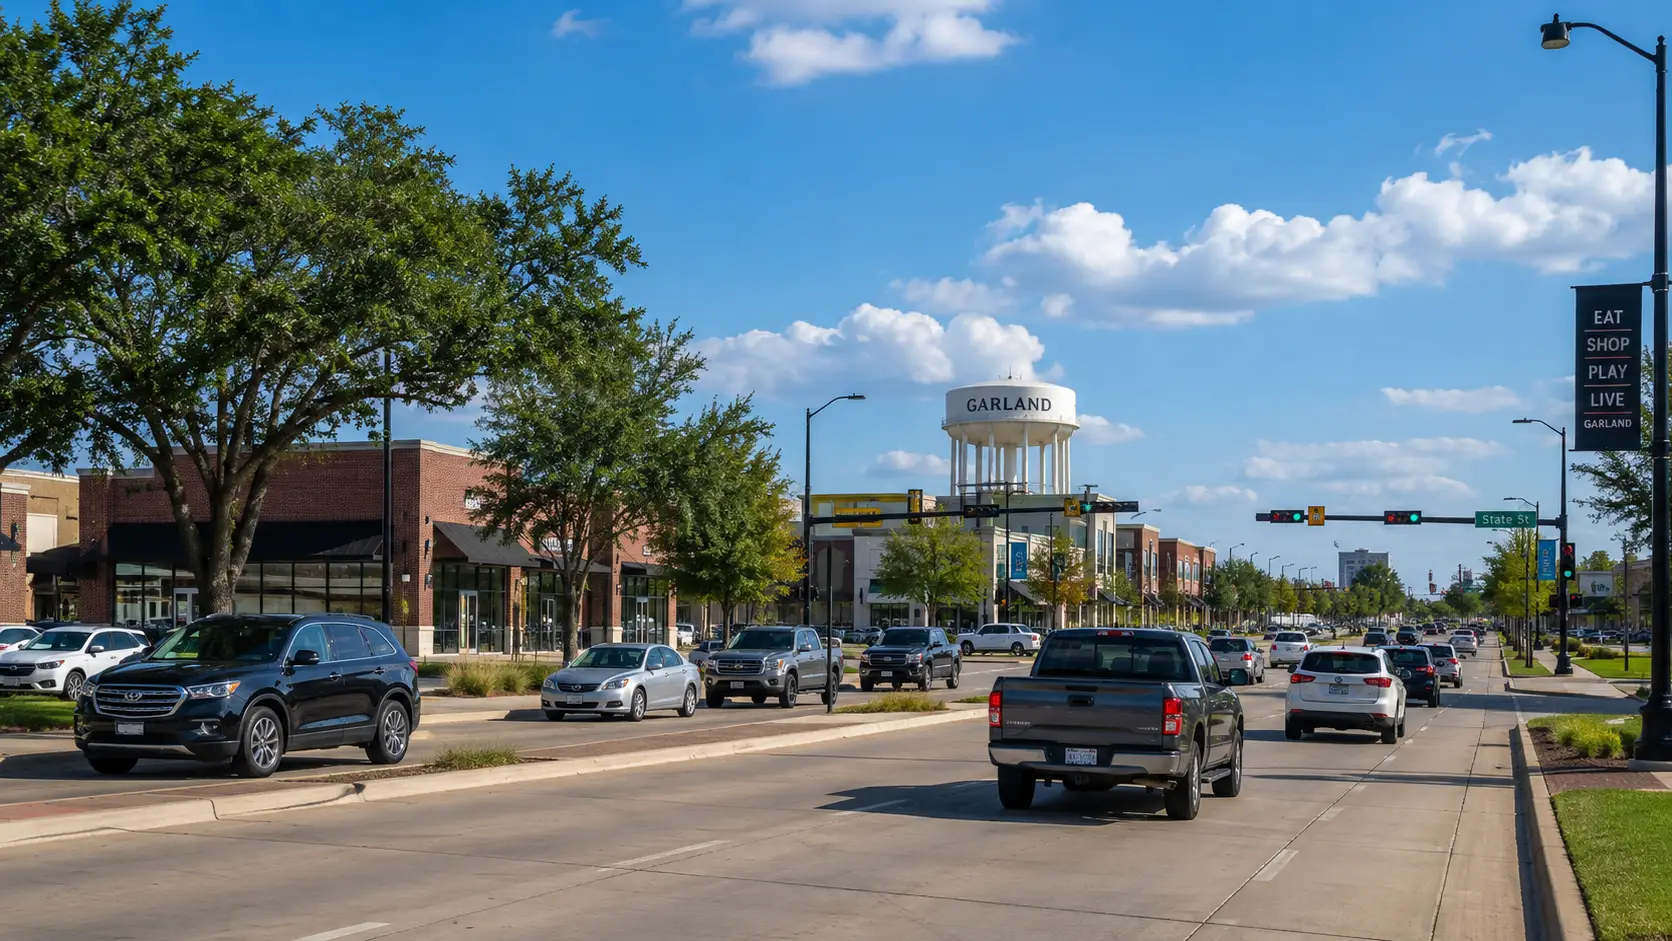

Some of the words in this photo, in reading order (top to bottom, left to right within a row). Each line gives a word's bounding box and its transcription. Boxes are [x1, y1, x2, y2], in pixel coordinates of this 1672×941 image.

[1594, 310, 1624, 325] EAT
[1587, 337, 1630, 352] SHOP
[1588, 364, 1628, 380] PLAY
[966, 396, 1052, 413] GARLAND
[1590, 392, 1625, 407] LIVE
[1584, 418, 1632, 429] GARLAND
[1482, 514, 1513, 525] State
[1517, 514, 1530, 525] St
